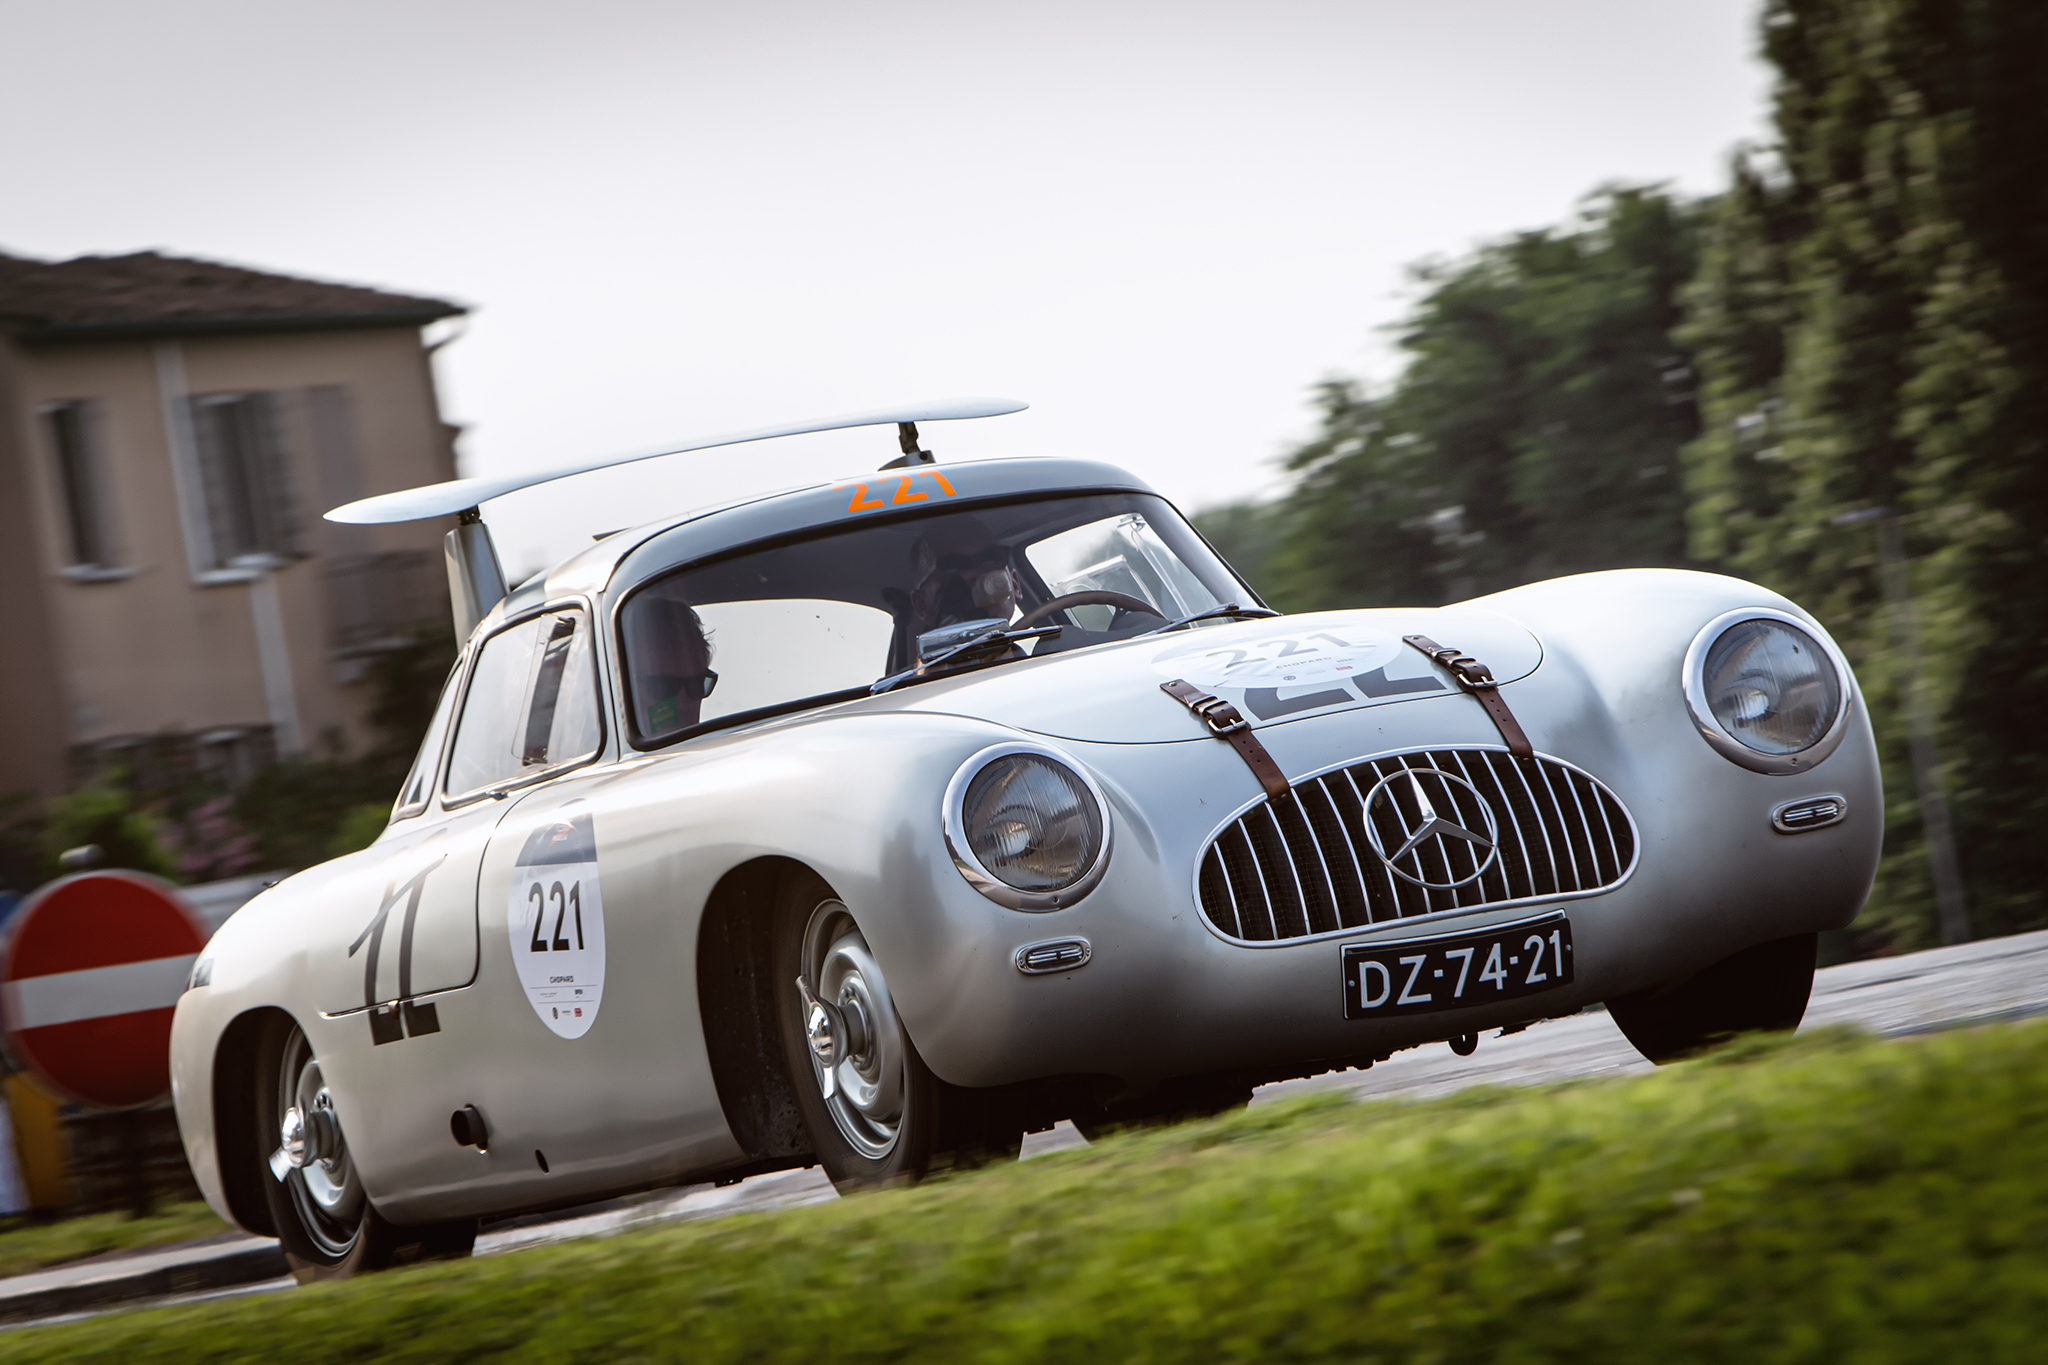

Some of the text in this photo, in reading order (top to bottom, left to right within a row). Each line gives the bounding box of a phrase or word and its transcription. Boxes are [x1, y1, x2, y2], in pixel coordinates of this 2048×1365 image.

[832, 469, 957, 513] 221
[1205, 632, 1352, 669] 221
[1275, 655, 1332, 669] CHOPARD
[528, 880, 585, 953] 221
